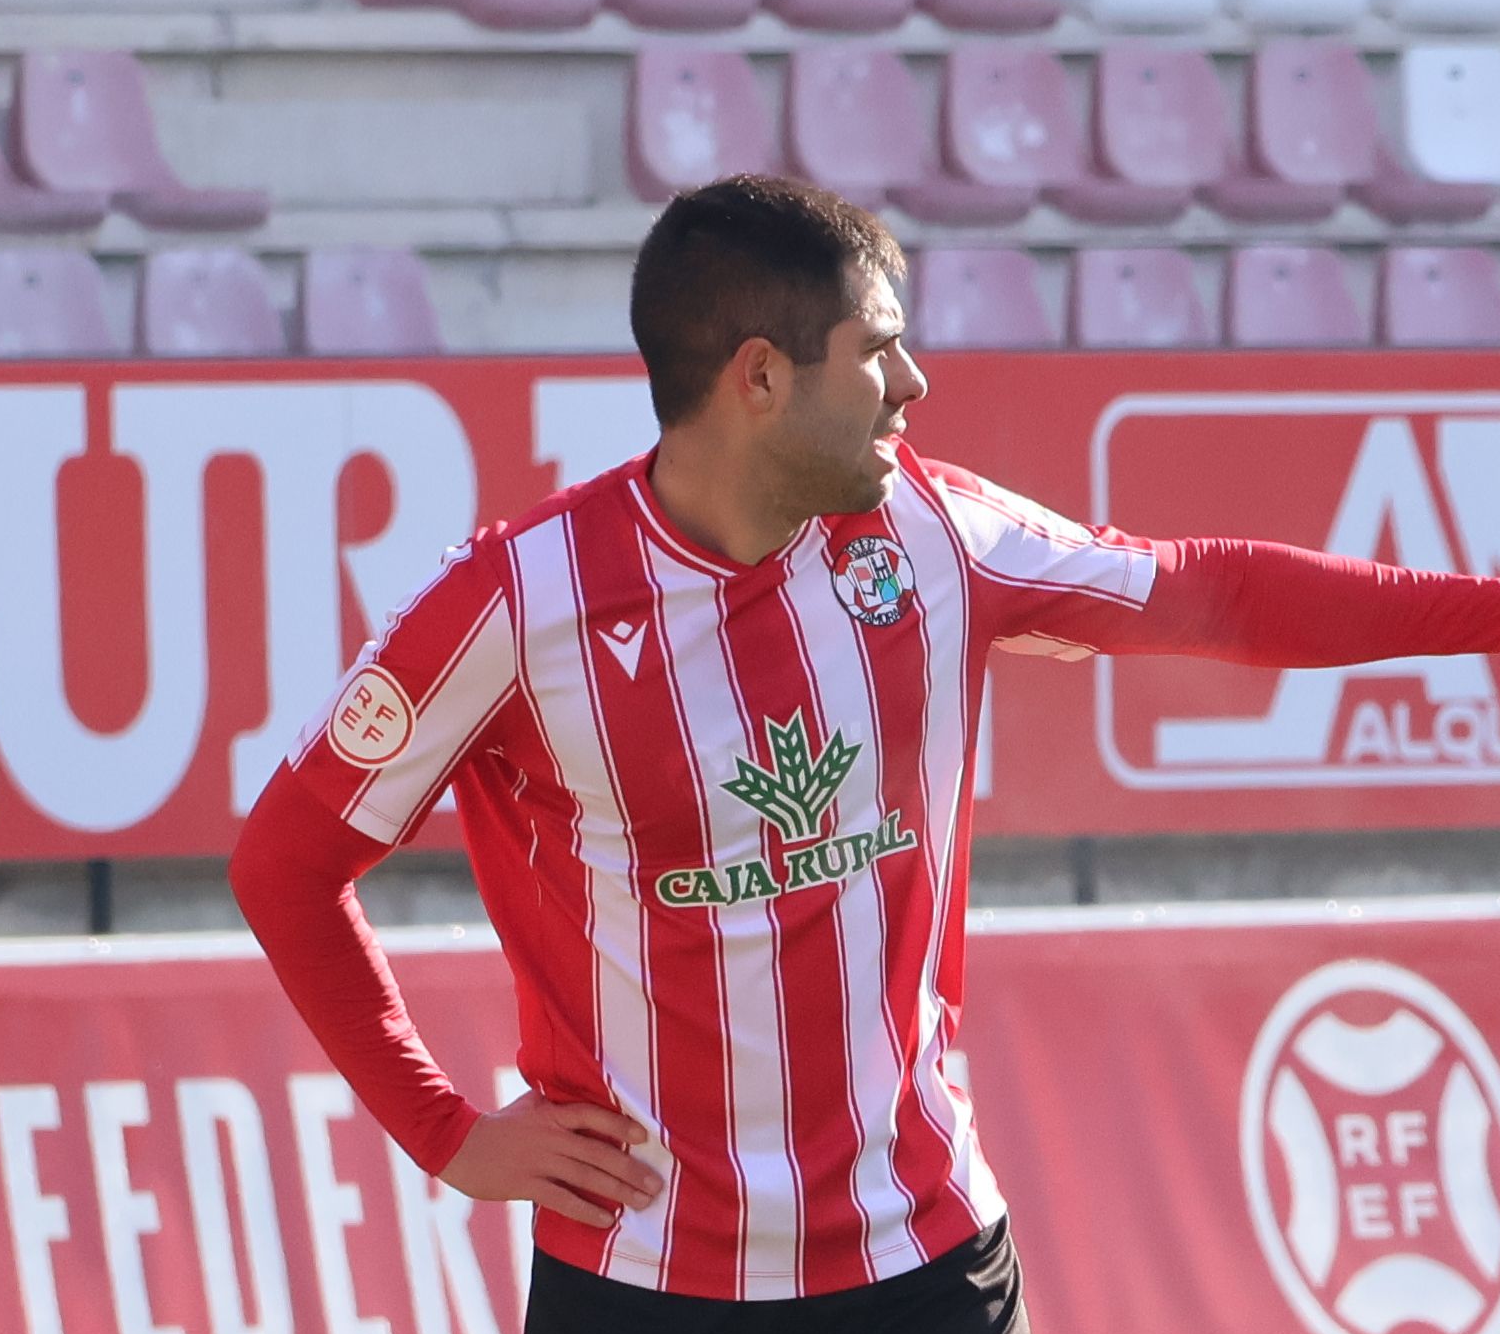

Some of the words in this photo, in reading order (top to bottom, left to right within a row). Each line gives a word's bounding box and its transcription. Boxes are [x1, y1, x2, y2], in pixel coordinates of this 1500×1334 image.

[657, 859, 782, 907] CAJA
[783, 812, 917, 892] RURAL
[1335, 1110, 1430, 1167] RF
[1348, 1182, 1442, 1240] EF
